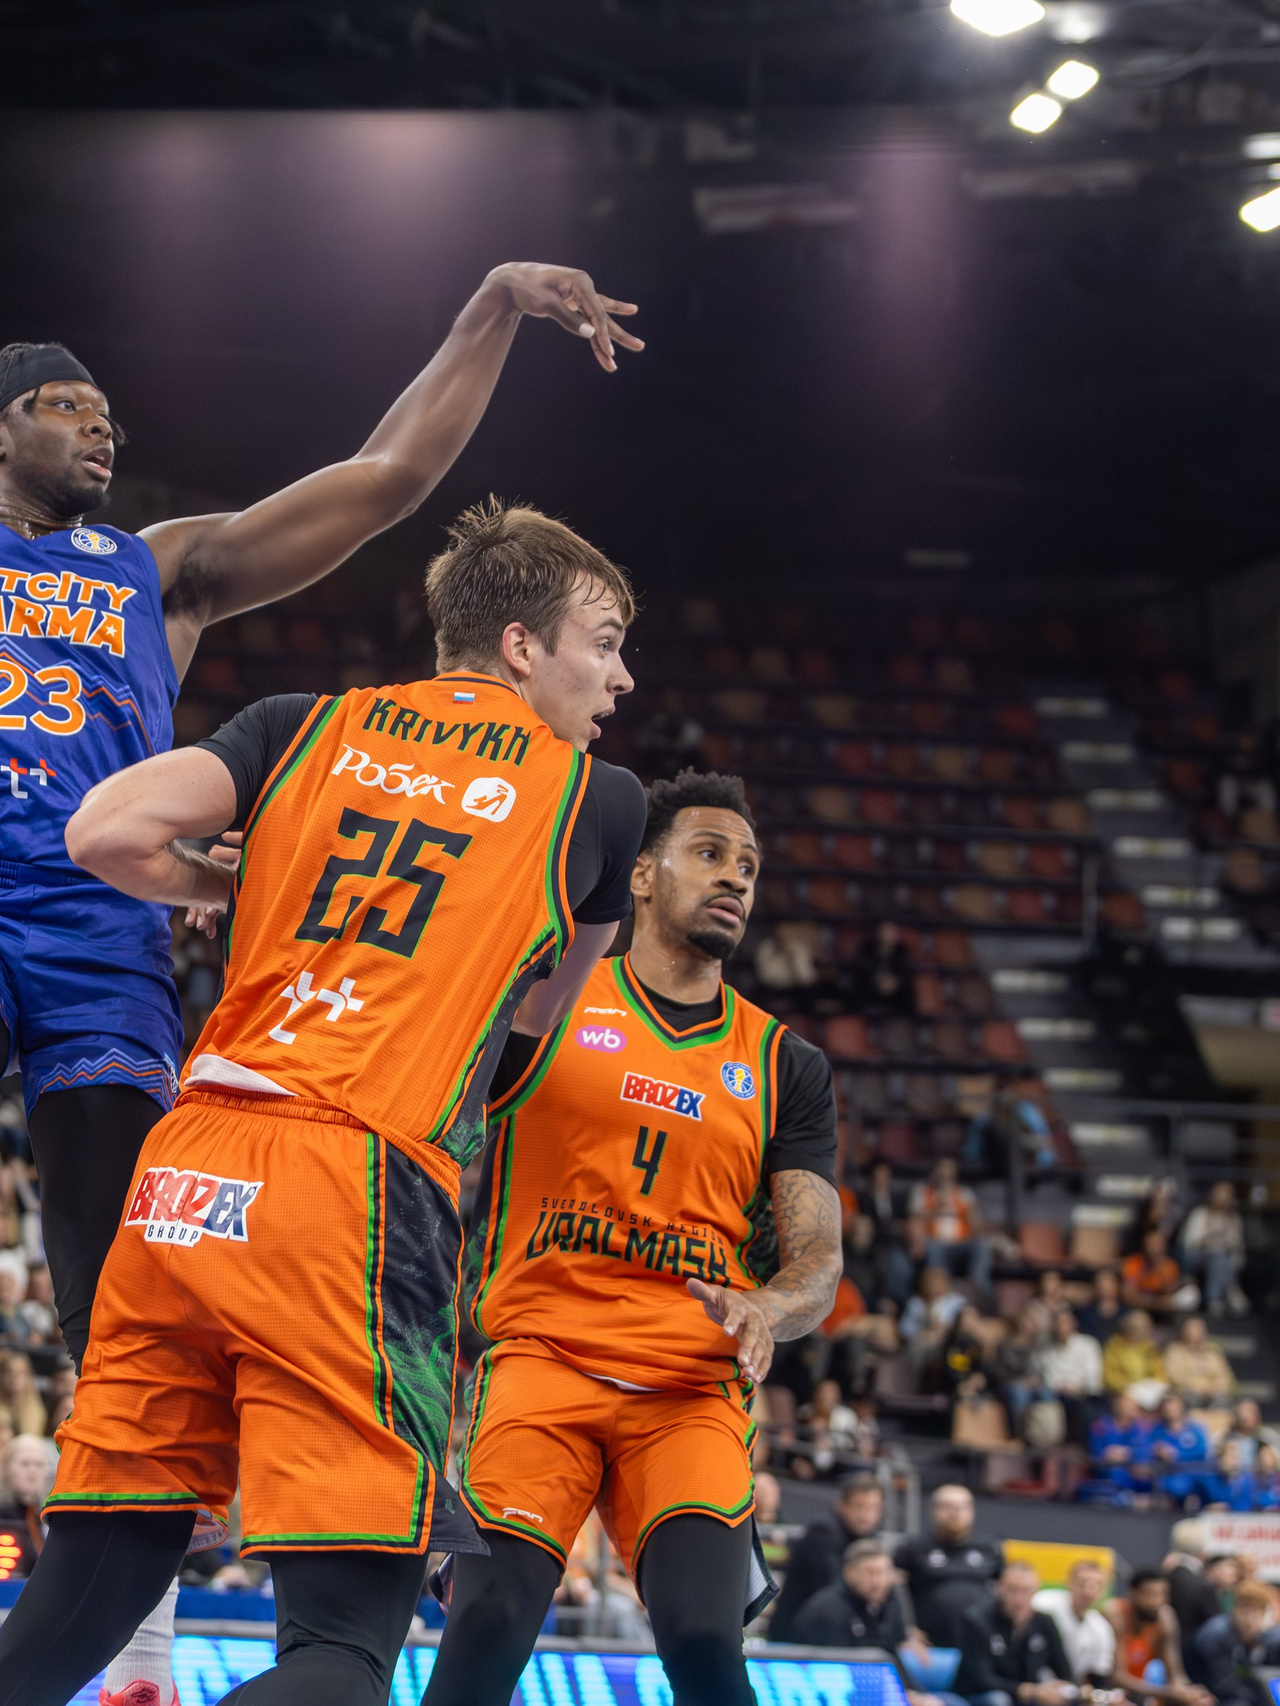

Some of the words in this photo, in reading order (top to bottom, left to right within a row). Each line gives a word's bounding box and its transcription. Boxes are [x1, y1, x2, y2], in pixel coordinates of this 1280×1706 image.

[294, 807, 474, 960] 25
[582, 1028, 621, 1049] wb
[622, 1074, 704, 1119] BROZEX
[632, 1125, 668, 1197] 4
[127, 1171, 258, 1238] BROZEX
[541, 1197, 652, 1228] SVERDLOVSK
[147, 1224, 199, 1243] GROUP
[523, 1211, 732, 1288] URALMASH
